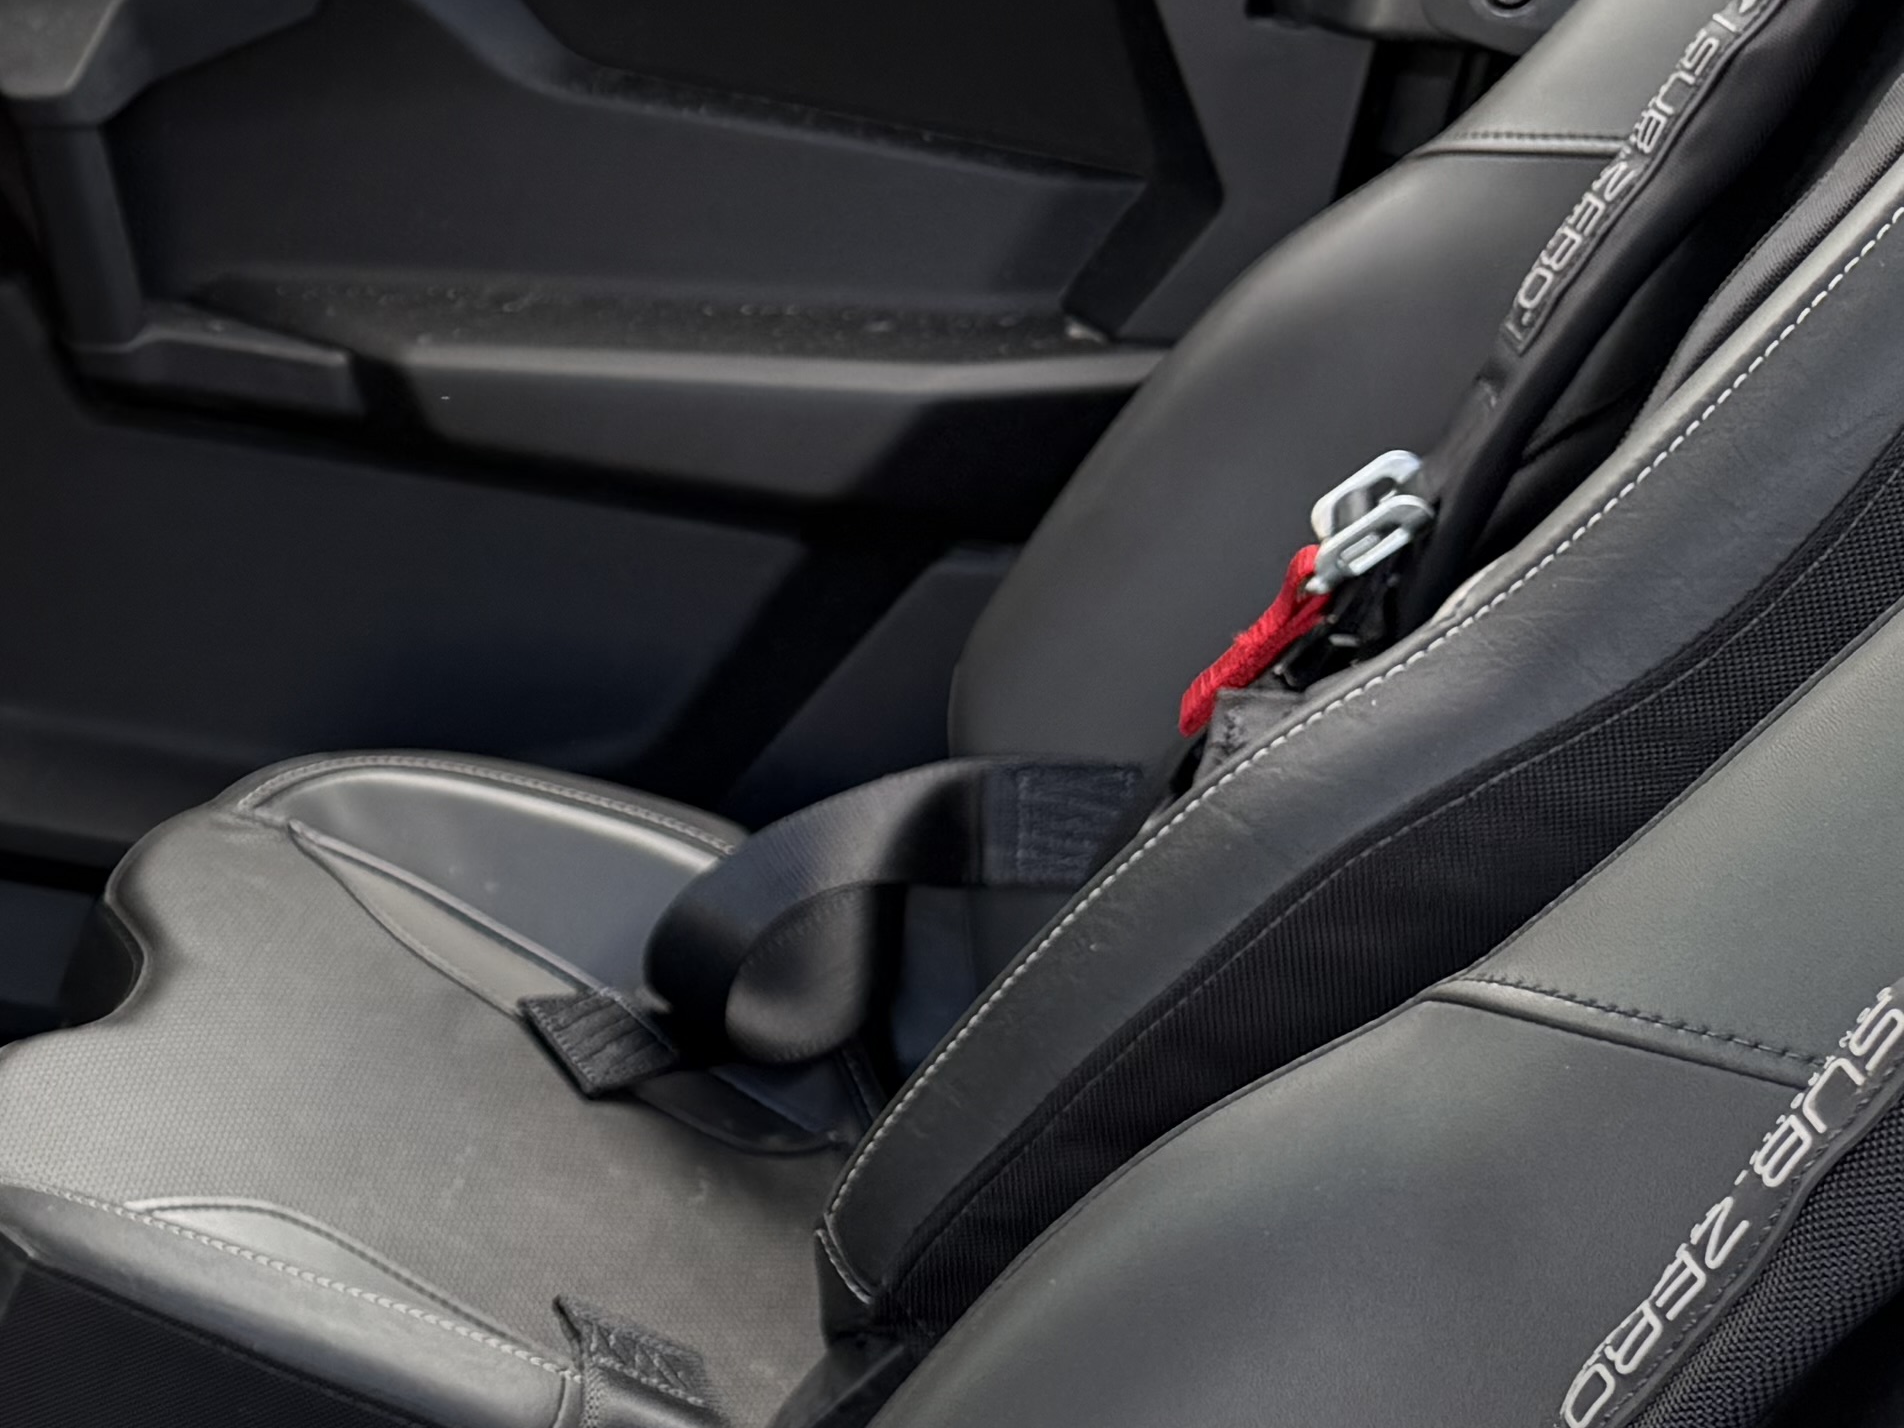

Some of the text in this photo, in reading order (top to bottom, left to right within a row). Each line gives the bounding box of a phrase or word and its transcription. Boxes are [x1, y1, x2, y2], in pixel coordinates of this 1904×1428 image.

[1633, 28, 1720, 154] SUB
[1515, 160, 1636, 309] ZERO
[1752, 986, 1904, 1188] SUB
